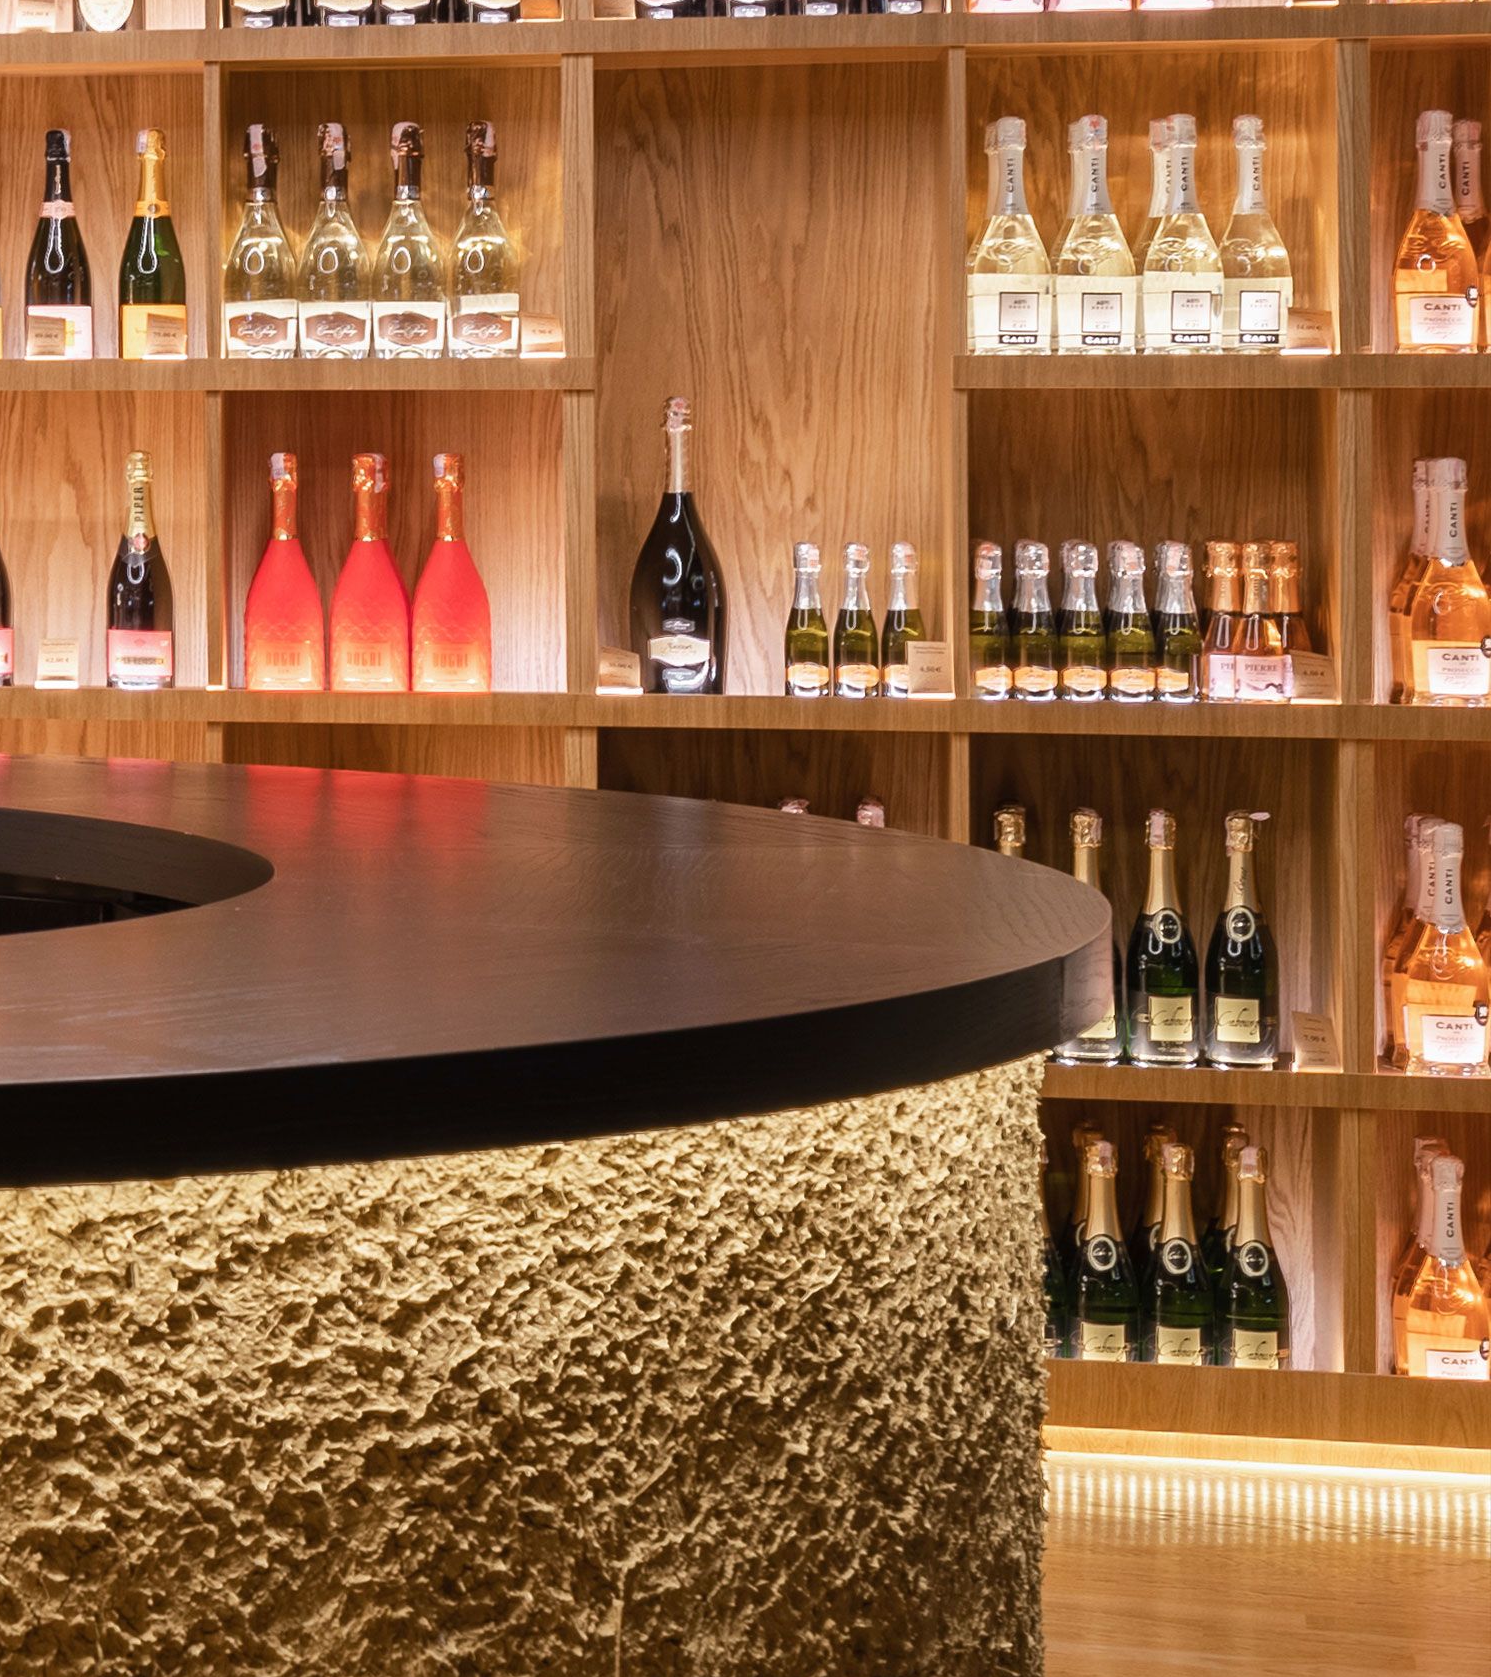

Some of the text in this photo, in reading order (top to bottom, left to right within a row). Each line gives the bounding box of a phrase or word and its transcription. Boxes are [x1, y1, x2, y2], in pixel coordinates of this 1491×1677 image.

[1006, 157, 1015, 194] CANTI
[1091, 157, 1100, 193] CANTI
[1181, 156, 1190, 192] CANTI
[1253, 156, 1261, 192] CANTI
[1462, 161, 1470, 196] CANTI
[1424, 303, 1461, 311] CANTI
[1001, 335, 1036, 344] CANTI
[1085, 337, 1119, 346] CANTI
[1174, 334, 1209, 344] CANTI
[134, 487, 144, 522] PIPER
[1449, 502, 1458, 538] CANTI
[1244, 663, 1278, 672] PIERRE
[1442, 652, 1479, 661] CANTI
[1444, 868, 1454, 904] CANTI
[1435, 1021, 1473, 1030] CANTI
[1446, 1201, 1455, 1238] CANTI
[1441, 1356, 1478, 1365] CANTI
